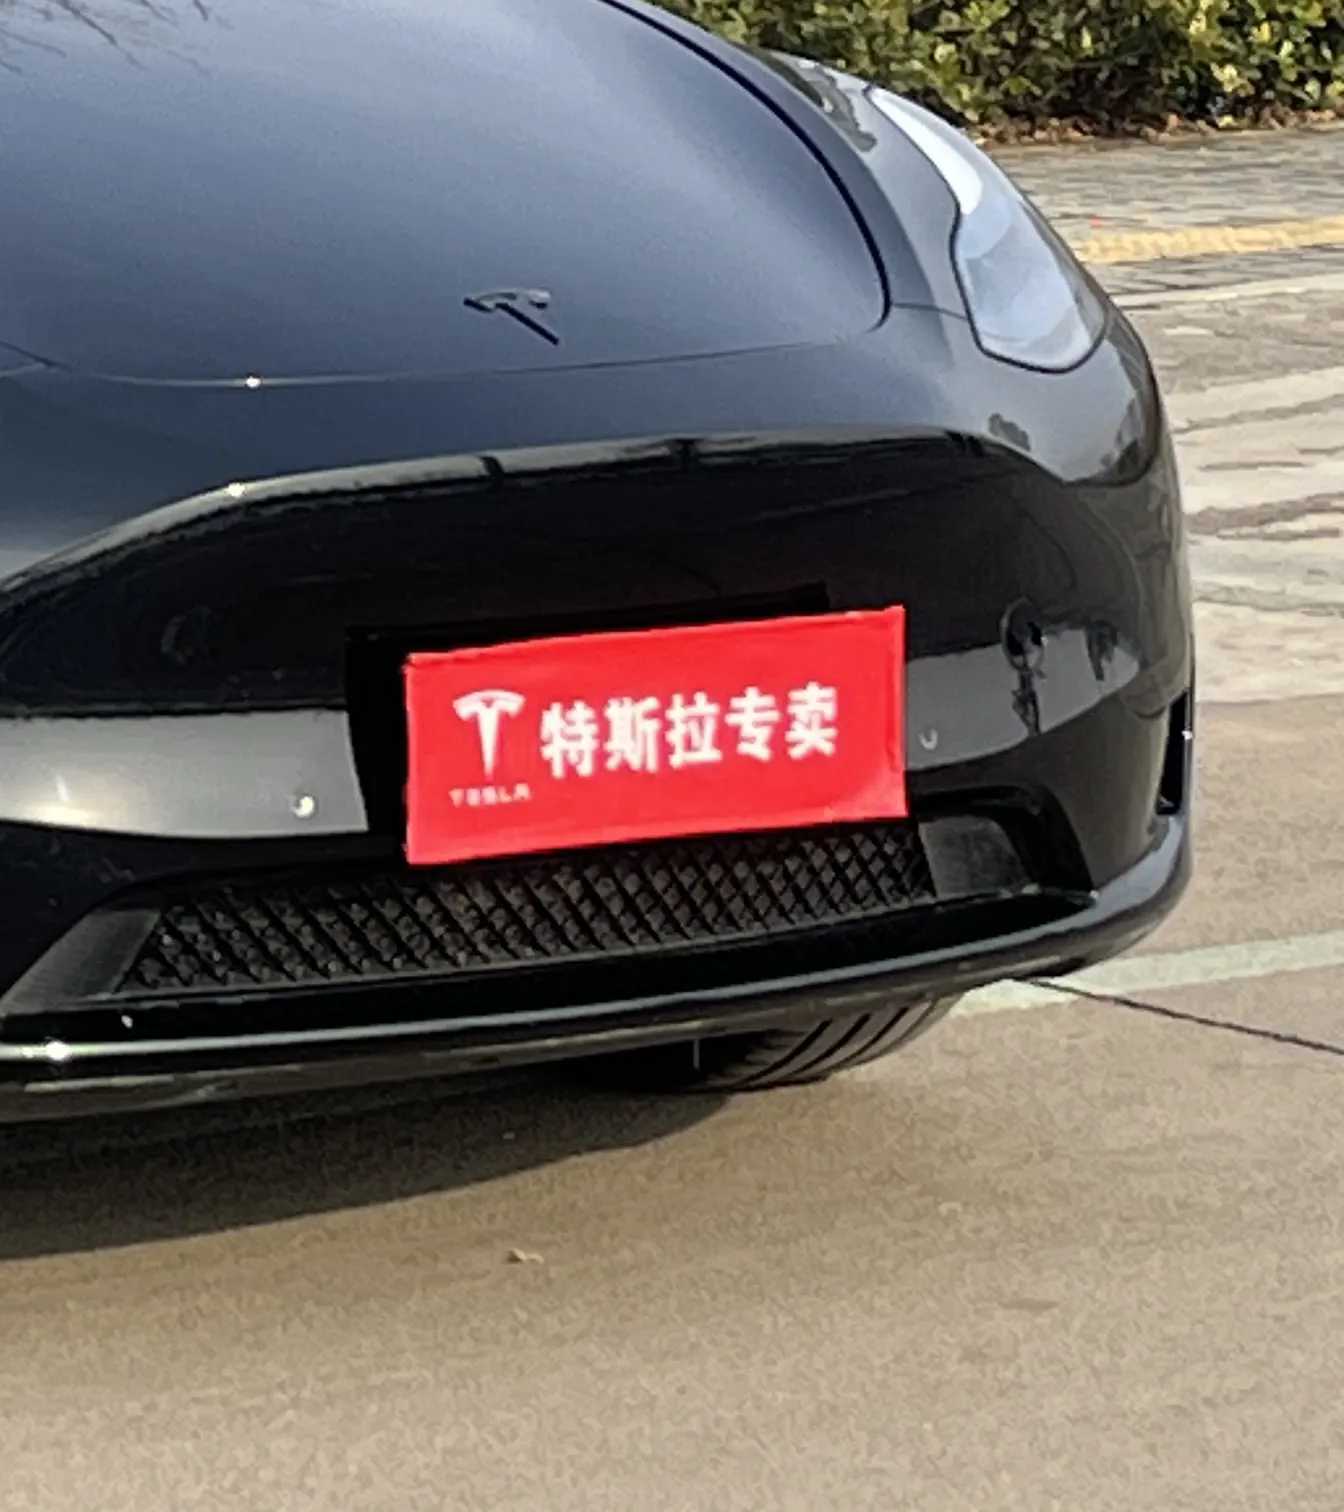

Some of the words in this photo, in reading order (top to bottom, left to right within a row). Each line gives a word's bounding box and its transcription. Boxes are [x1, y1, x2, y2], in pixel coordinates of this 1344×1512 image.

[539, 680, 839, 780] 特斯拉专卖
